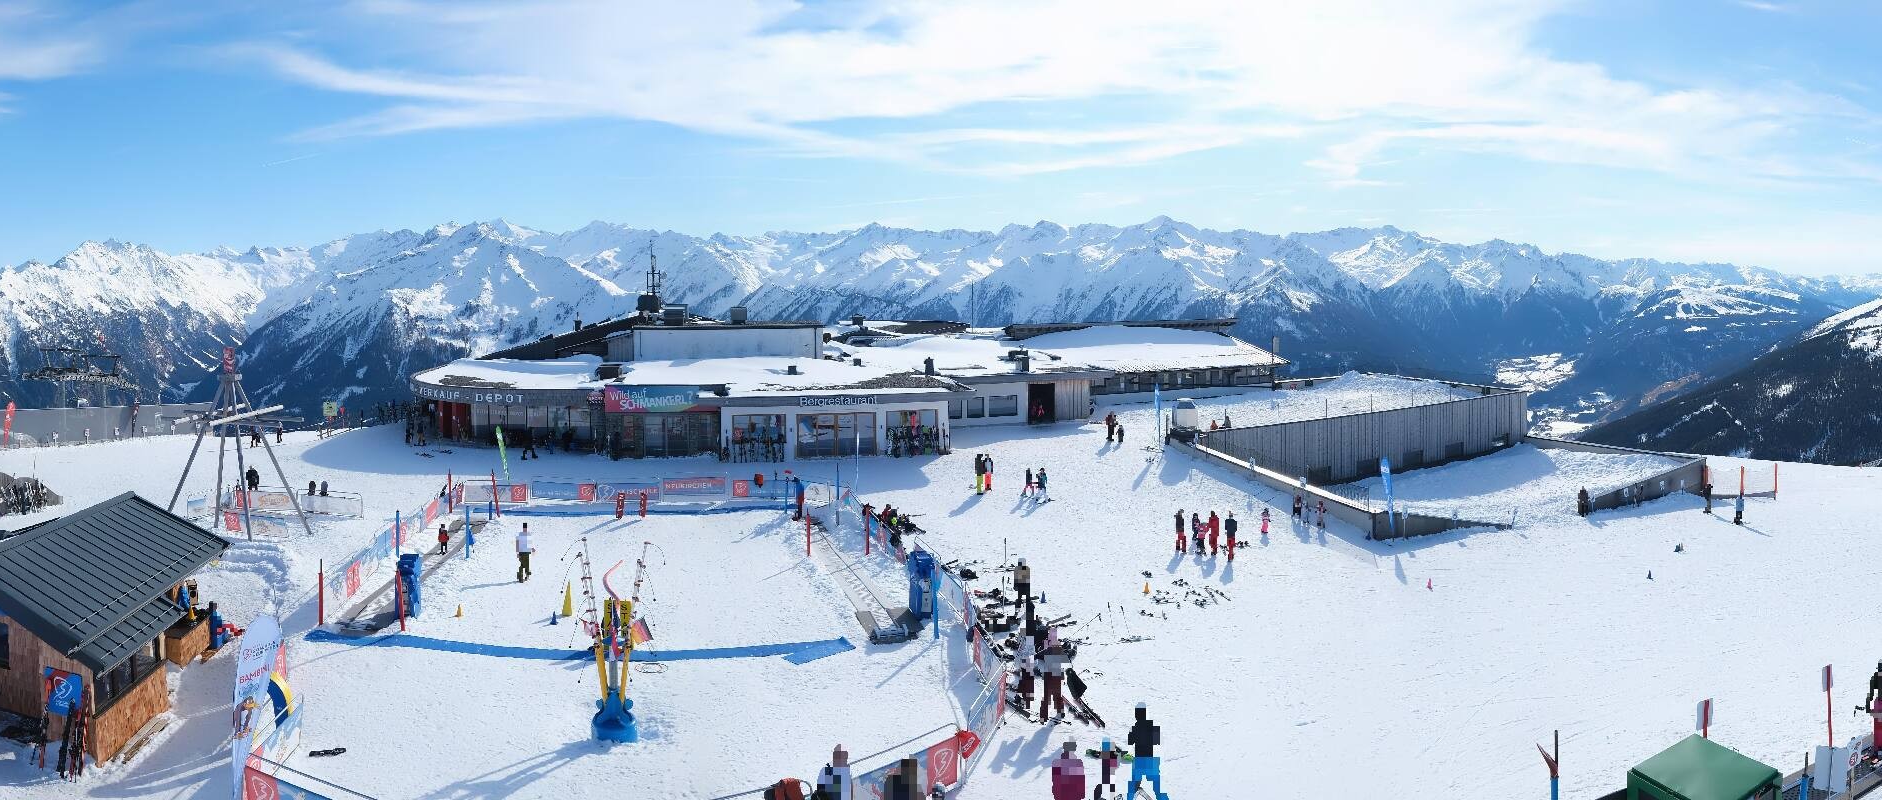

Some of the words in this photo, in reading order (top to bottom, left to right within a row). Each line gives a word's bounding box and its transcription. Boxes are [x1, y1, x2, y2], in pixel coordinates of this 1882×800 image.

[419, 387, 460, 400] VERKAUF
[475, 393, 524, 404] DEPOT
[609, 390, 630, 401] Wild
[632, 388, 647, 399] auf
[799, 395, 877, 407] Bergrestaurant
[239, 663, 270, 684] BAMBINI
